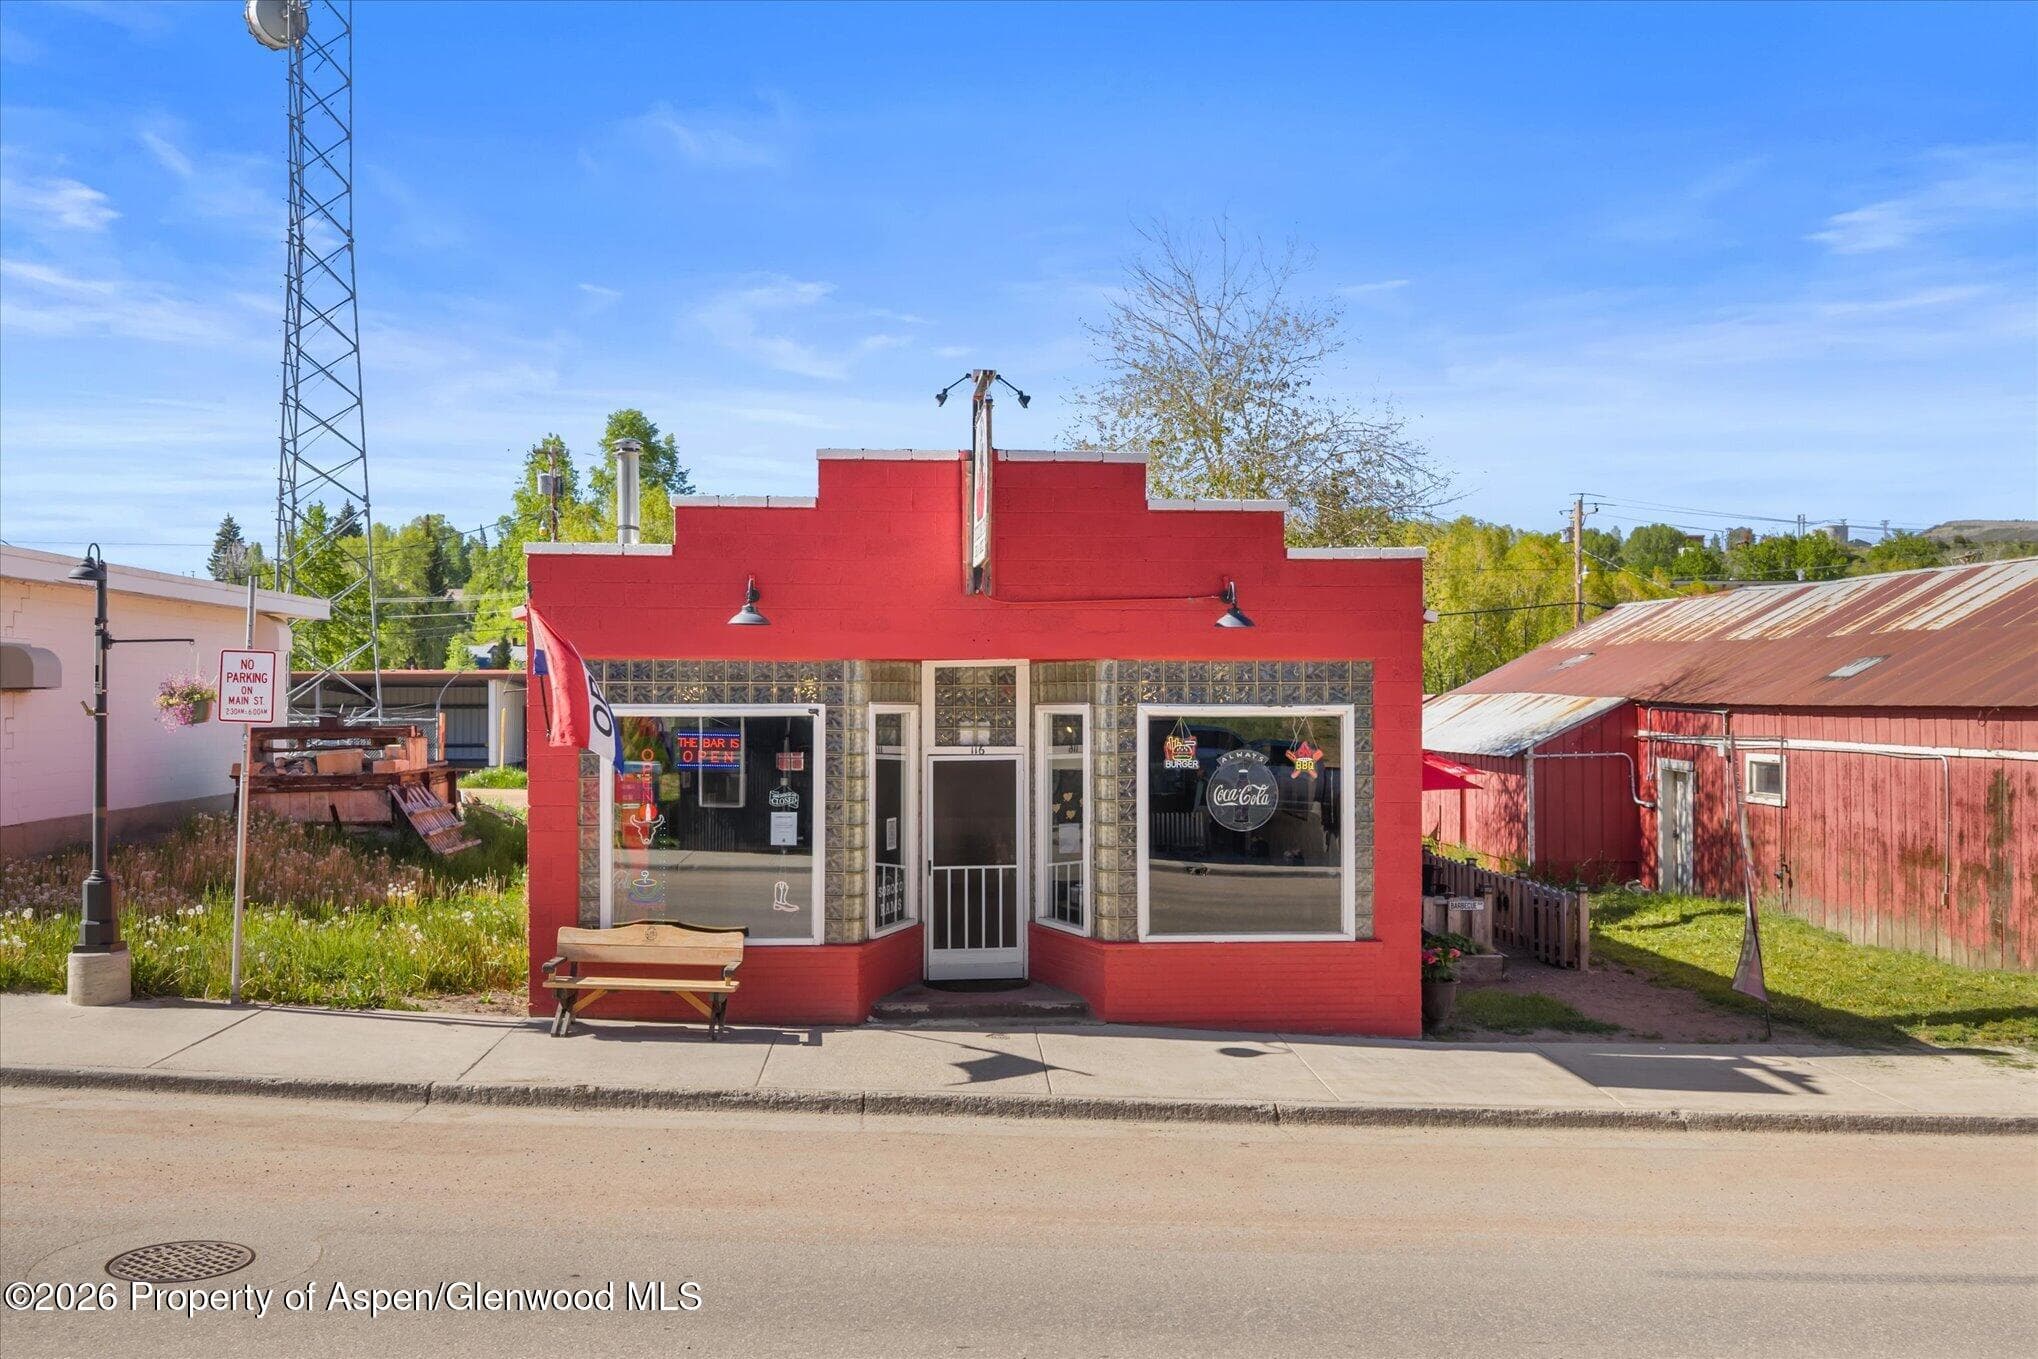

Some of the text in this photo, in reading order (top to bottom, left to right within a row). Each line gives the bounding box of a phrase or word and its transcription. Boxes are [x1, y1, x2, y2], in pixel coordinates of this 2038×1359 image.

[240, 659, 255, 670] NO
[226, 672, 268, 684] PARKING
[241, 686, 253, 695] ON
[228, 696, 249, 705] MAIN
[588, 675, 613, 737] OP
[677, 737, 741, 749] THE BAR IS
[971, 744, 985, 755] 116
[682, 750, 734, 763] OPEN
[1221, 751, 1265, 763] ALWAYS
[1165, 760, 1200, 769] BURGER
[1295, 760, 1315, 770] BBQ
[1213, 784, 1270, 806] Coca-Cola
[880, 898, 902, 917] RAMS
